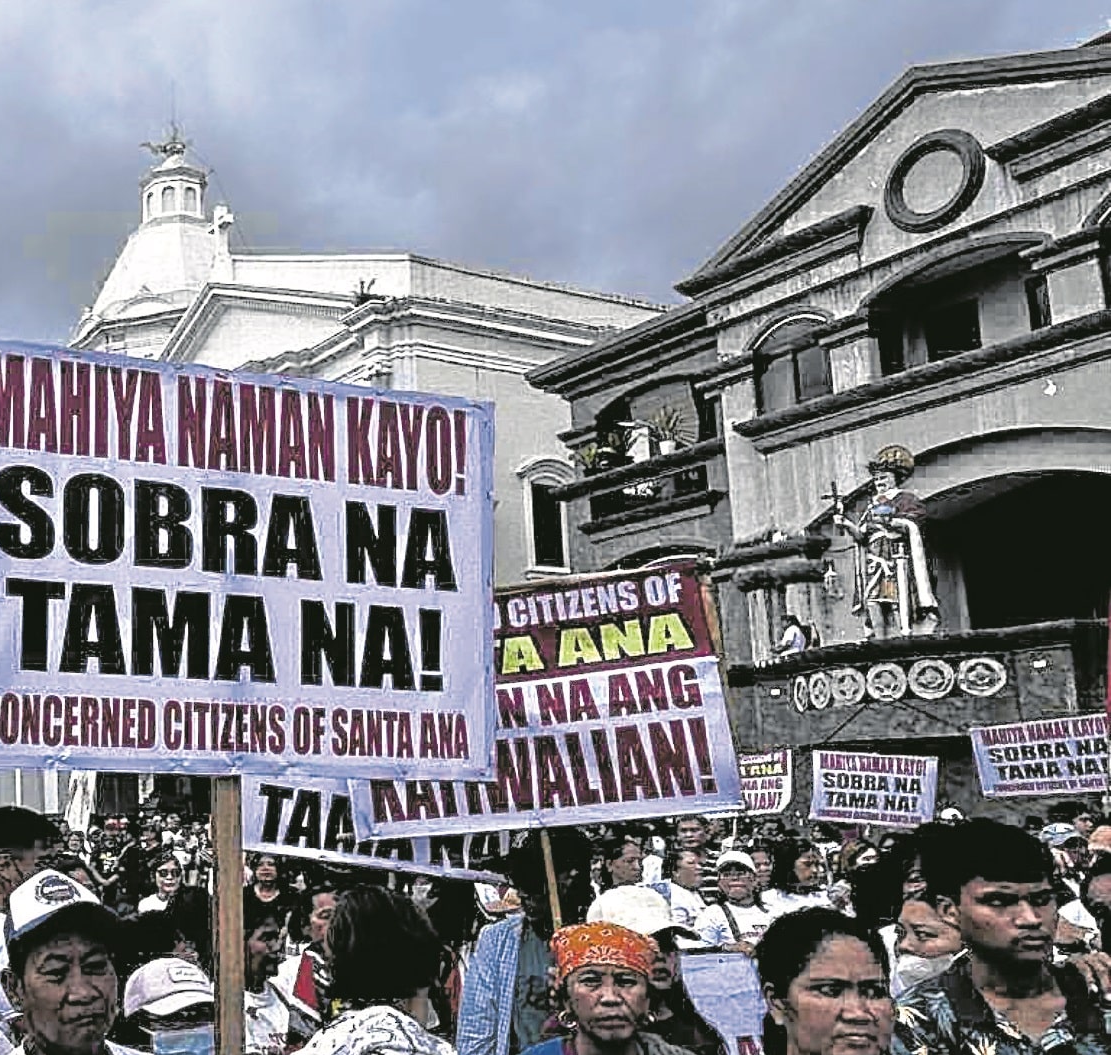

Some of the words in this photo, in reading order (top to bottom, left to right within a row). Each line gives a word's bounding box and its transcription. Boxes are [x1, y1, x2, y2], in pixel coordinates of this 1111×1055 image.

[177, 374, 336, 483] NAMAN
[347, 396, 467, 496] KAYO!
[345, 499, 459, 593] NA
[507, 580, 639, 629] CITIZENS
[644, 572, 683, 607] OF
[4, 576, 277, 684] TAMA
[300, 597, 444, 693] NA!
[557, 612, 695, 667] ANA
[537, 678, 600, 727] NA
[607, 663, 704, 719] ANG
[163, 700, 286, 756] CITIZENS
[293, 705, 326, 755] OF
[331, 706, 413, 759] SANTA
[419, 710, 470, 760] ANA
[989, 741, 1070, 764] SOBRA
[823, 773, 890, 792] SOBRA
[894, 777, 922, 794] NA
[997, 759, 1064, 781] TAMA
[825, 791, 880, 809] TAMA
